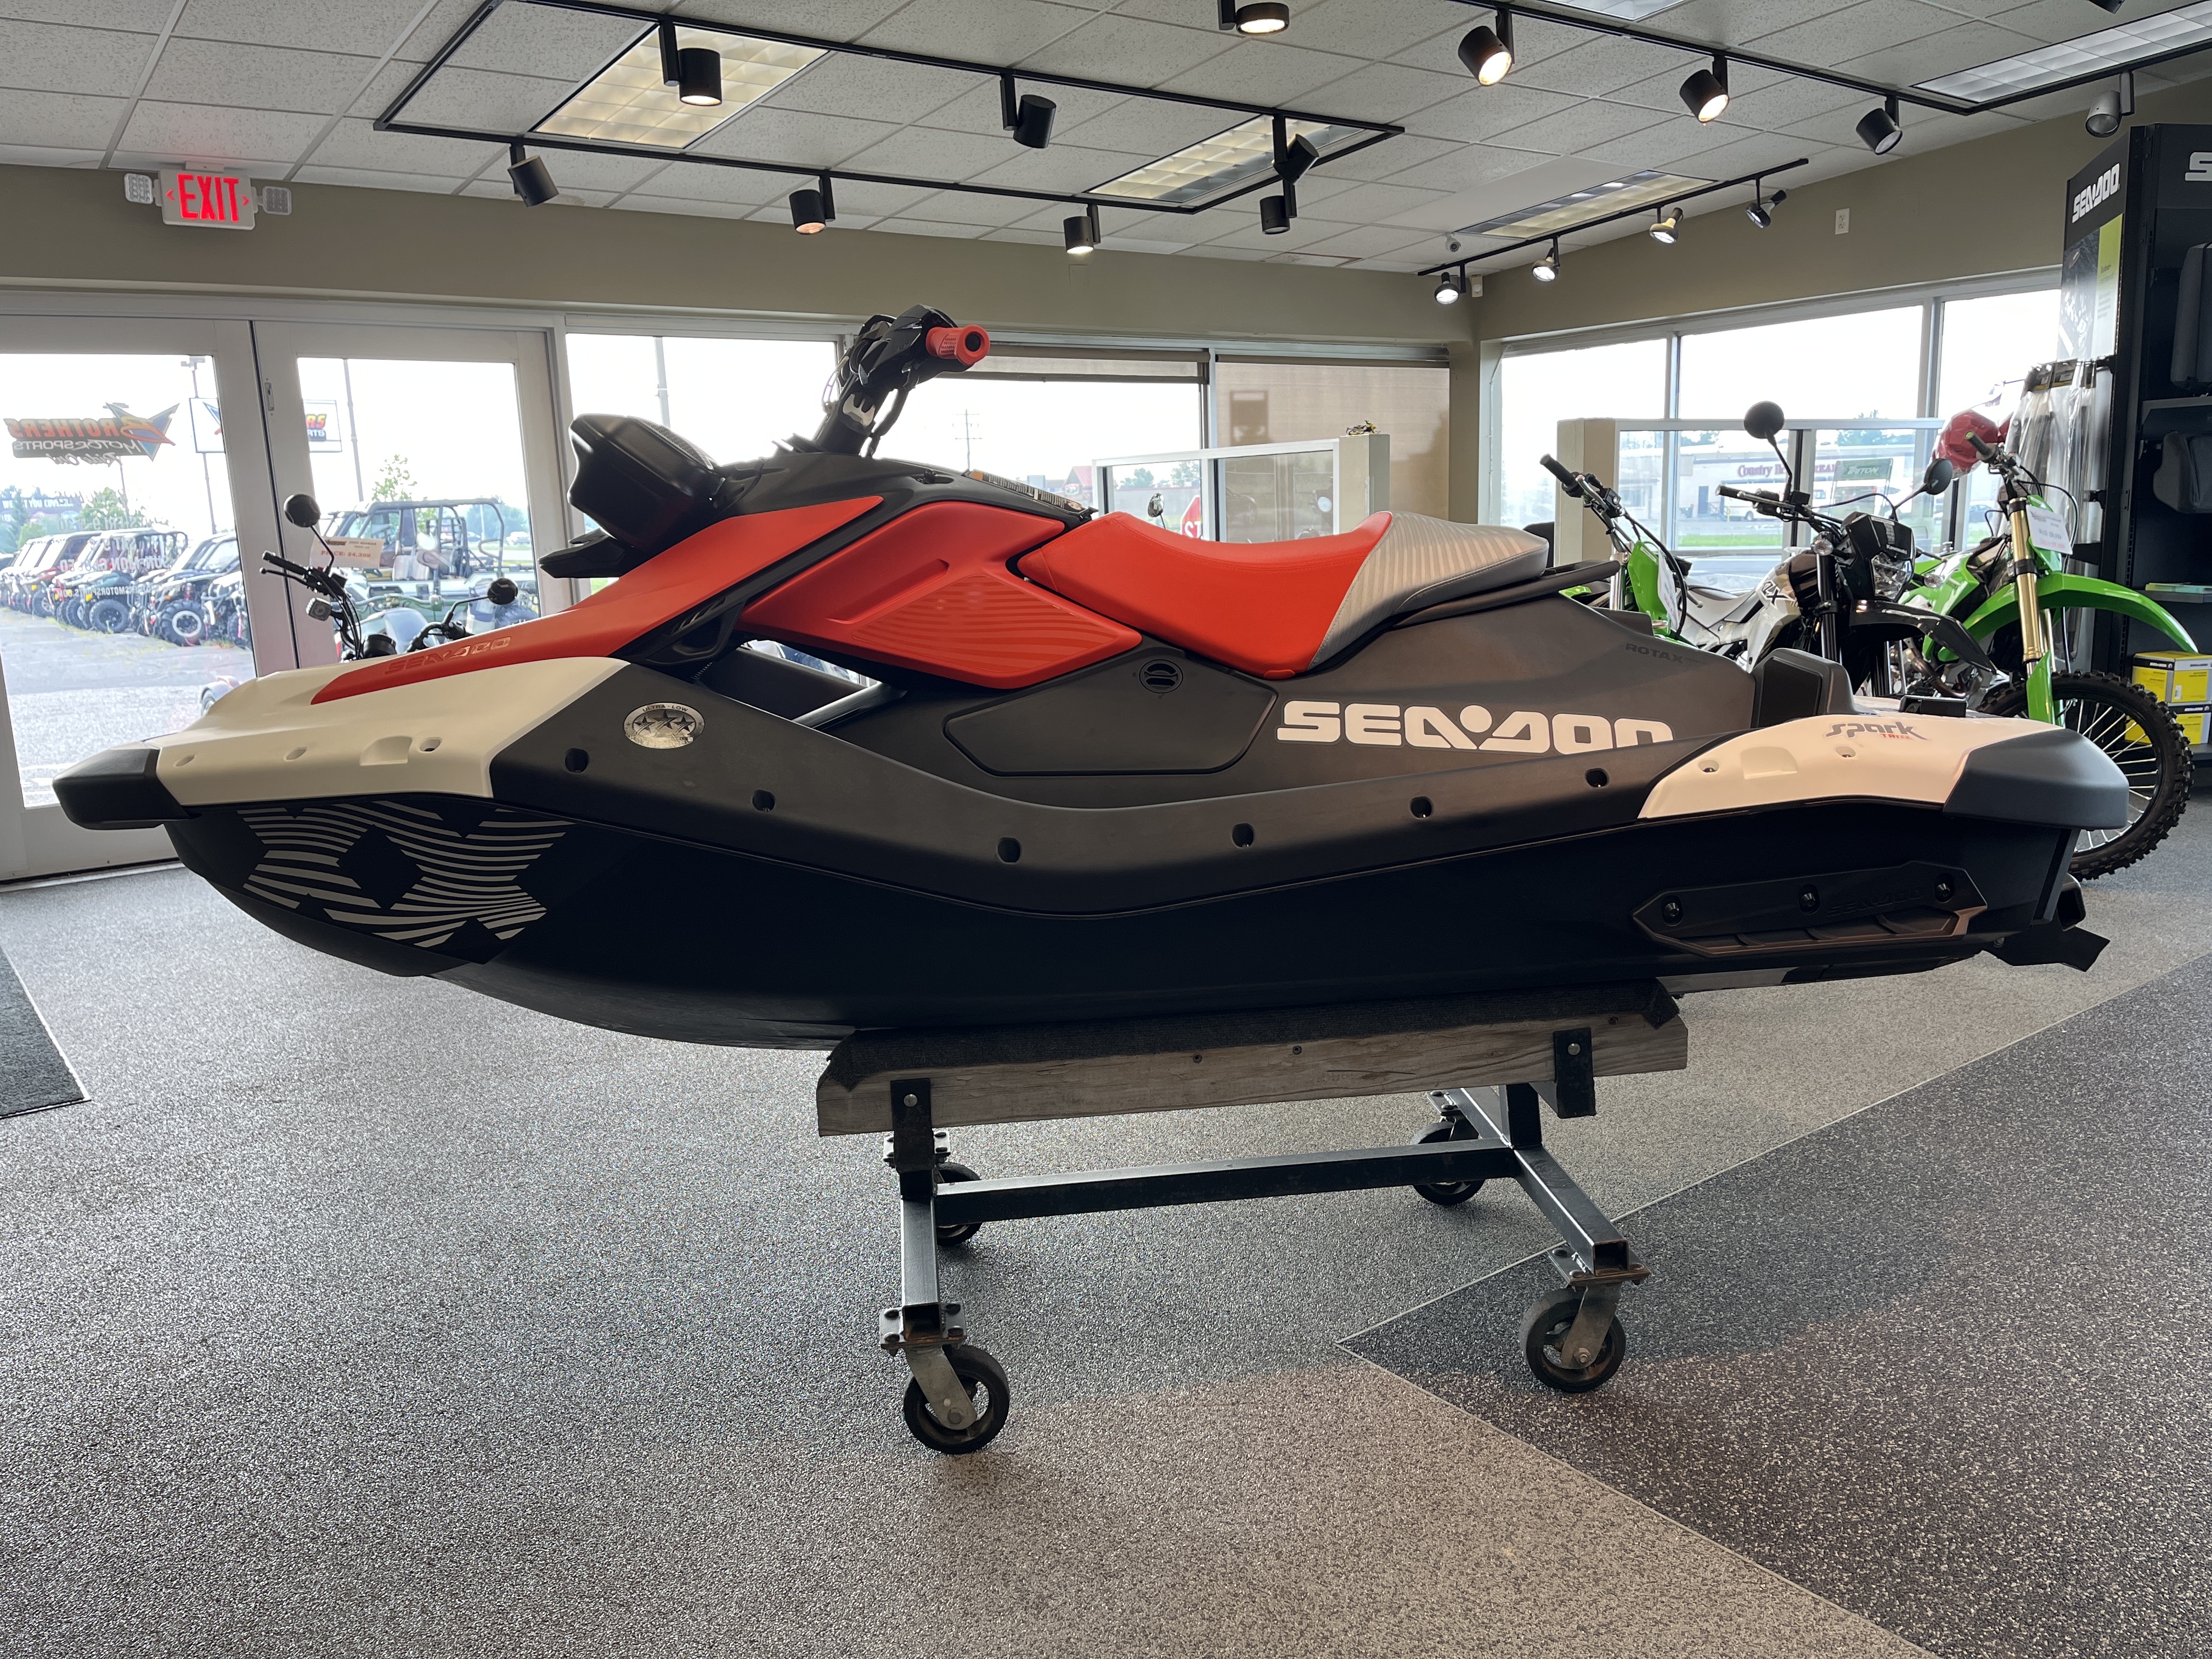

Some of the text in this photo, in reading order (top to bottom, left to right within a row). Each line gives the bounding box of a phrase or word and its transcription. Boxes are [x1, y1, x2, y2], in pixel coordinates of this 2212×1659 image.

[177, 173, 239, 223] EXIT
[1738, 465, 1773, 478] Country
[1847, 465, 1879, 475] TRITON
[1185, 521, 1201, 538] ST
[1625, 643, 1684, 664] ROTAX
